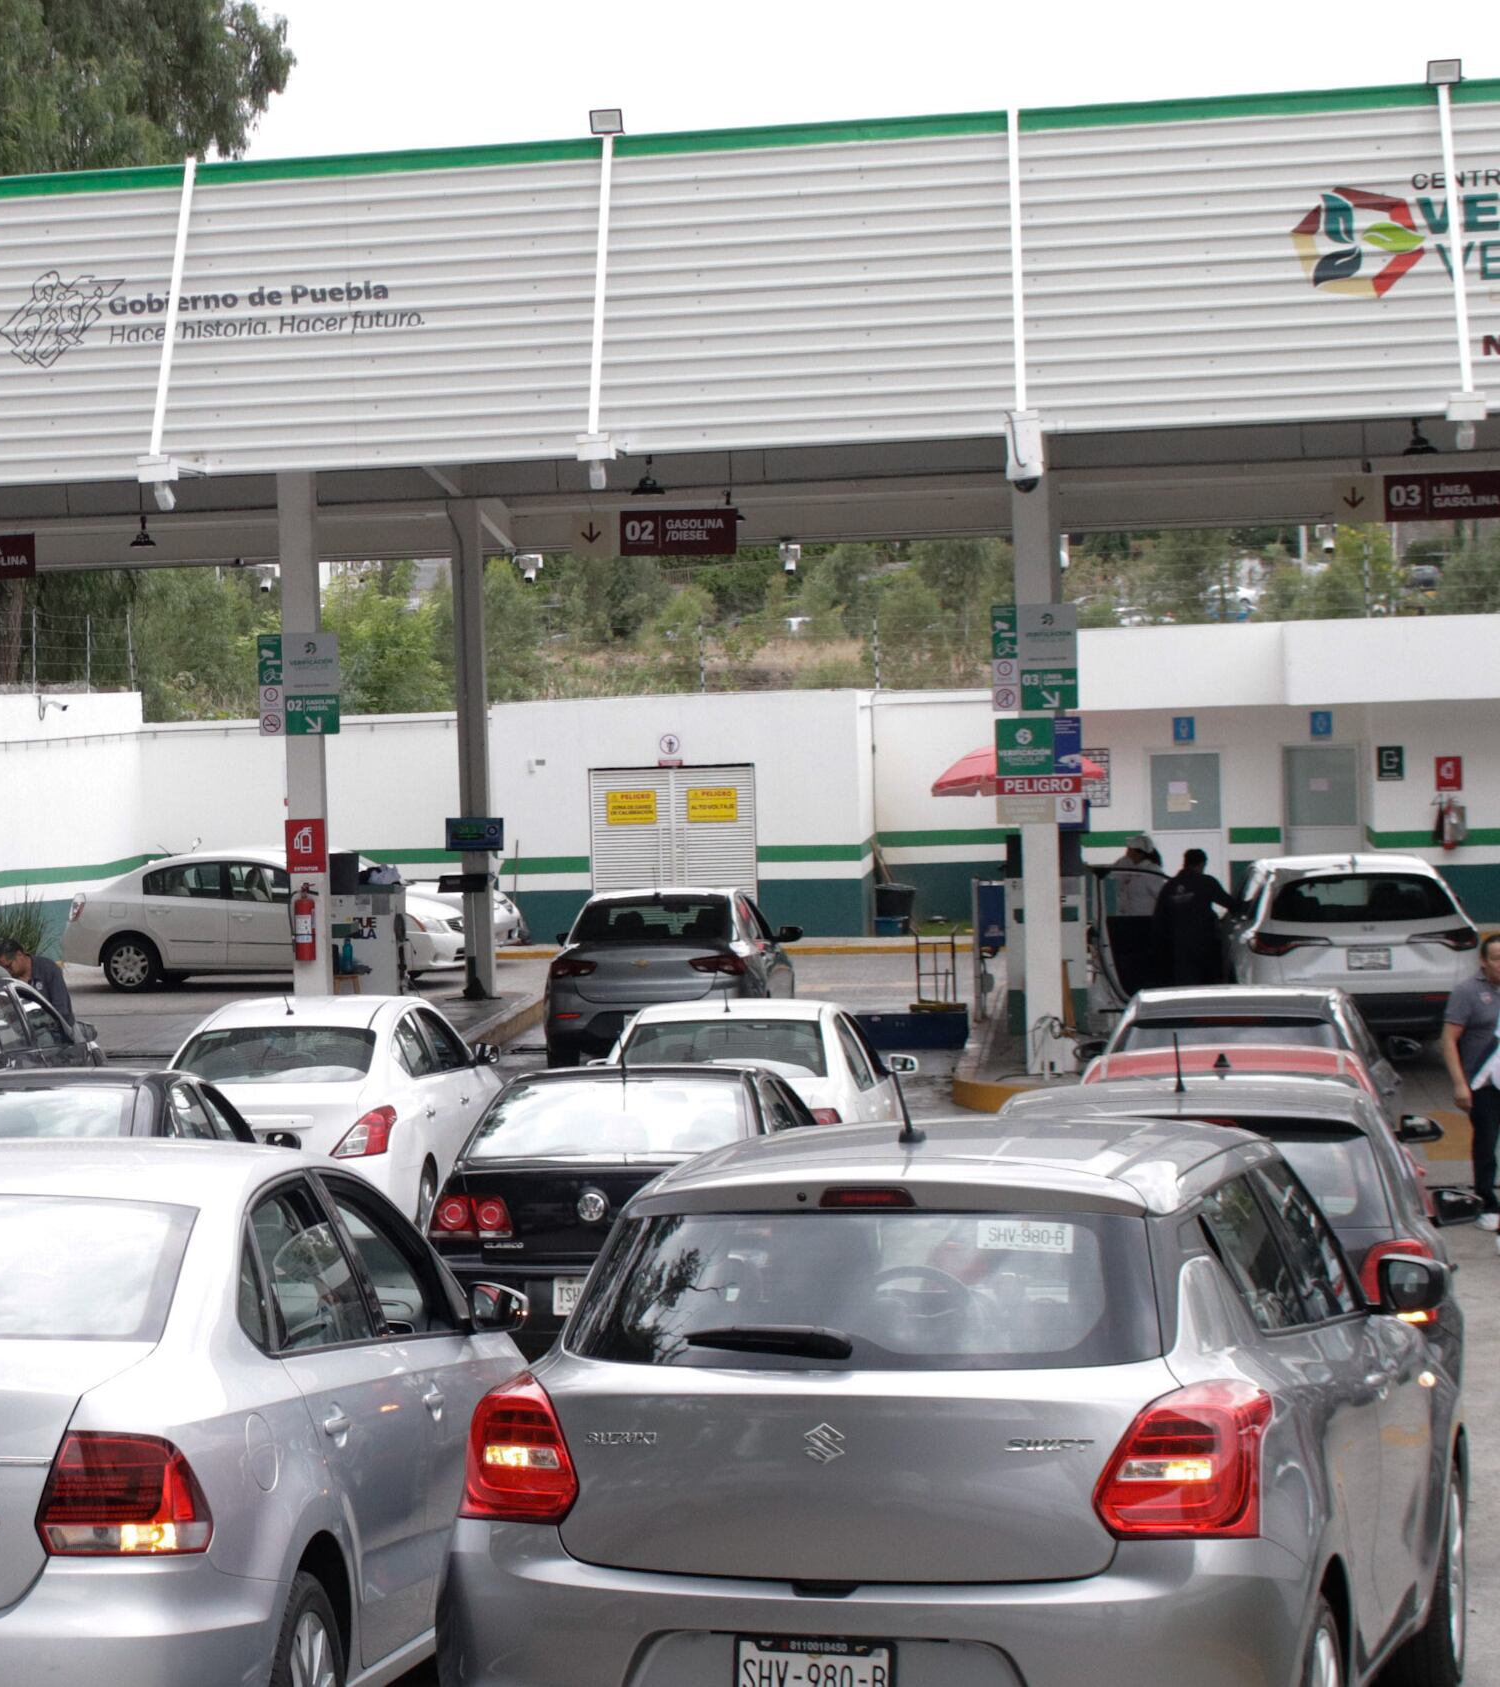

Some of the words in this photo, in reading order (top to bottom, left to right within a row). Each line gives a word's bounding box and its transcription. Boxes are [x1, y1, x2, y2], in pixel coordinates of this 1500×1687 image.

[108, 291, 238, 315] Gobierno
[248, 286, 283, 306] de
[292, 281, 389, 303] Puebla
[109, 321, 179, 345] Hace
[182, 319, 272, 340] historia.
[279, 316, 347, 334] Hacer
[350, 311, 425, 334] futuro.
[1390, 484, 1420, 507] 03
[1432, 483, 1471, 496] LÍNEA
[1432, 495, 1500, 508] GASOLINA
[625, 521, 654, 541] 02
[665, 518, 724, 529] GASOLINA
[665, 530, 710, 542] /DIESEL
[287, 700, 303, 711] 02
[1004, 778, 1073, 793] PELIGRO
[988, 1226, 1065, 1246] SHV-980-B
[743, 1659, 886, 1687] SHV-980-B
